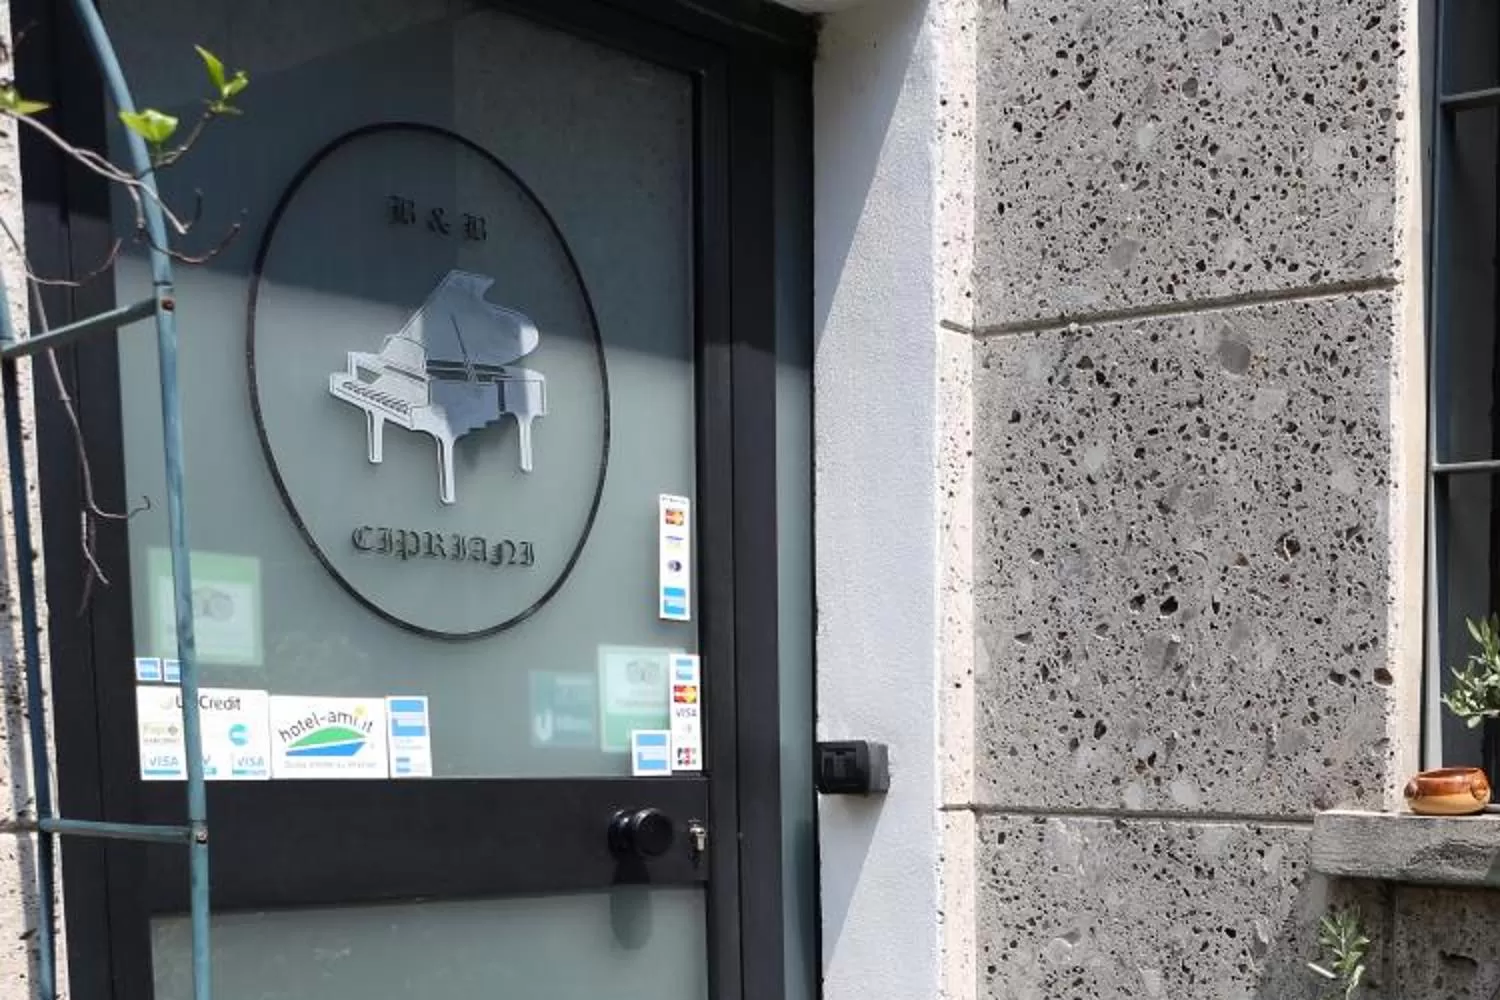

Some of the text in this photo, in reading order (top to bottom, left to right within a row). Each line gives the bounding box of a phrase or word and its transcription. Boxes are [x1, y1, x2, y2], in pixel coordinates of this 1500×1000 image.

[384, 194, 487, 241] B & B
[352, 525, 535, 567] CIPRIANI
[175, 695, 241, 711] UCredit
[675, 708, 698, 718] VISA
[278, 710, 373, 742] hotel-ami.it
[149, 756, 179, 767] VISA
[237, 756, 265, 767] VISA
